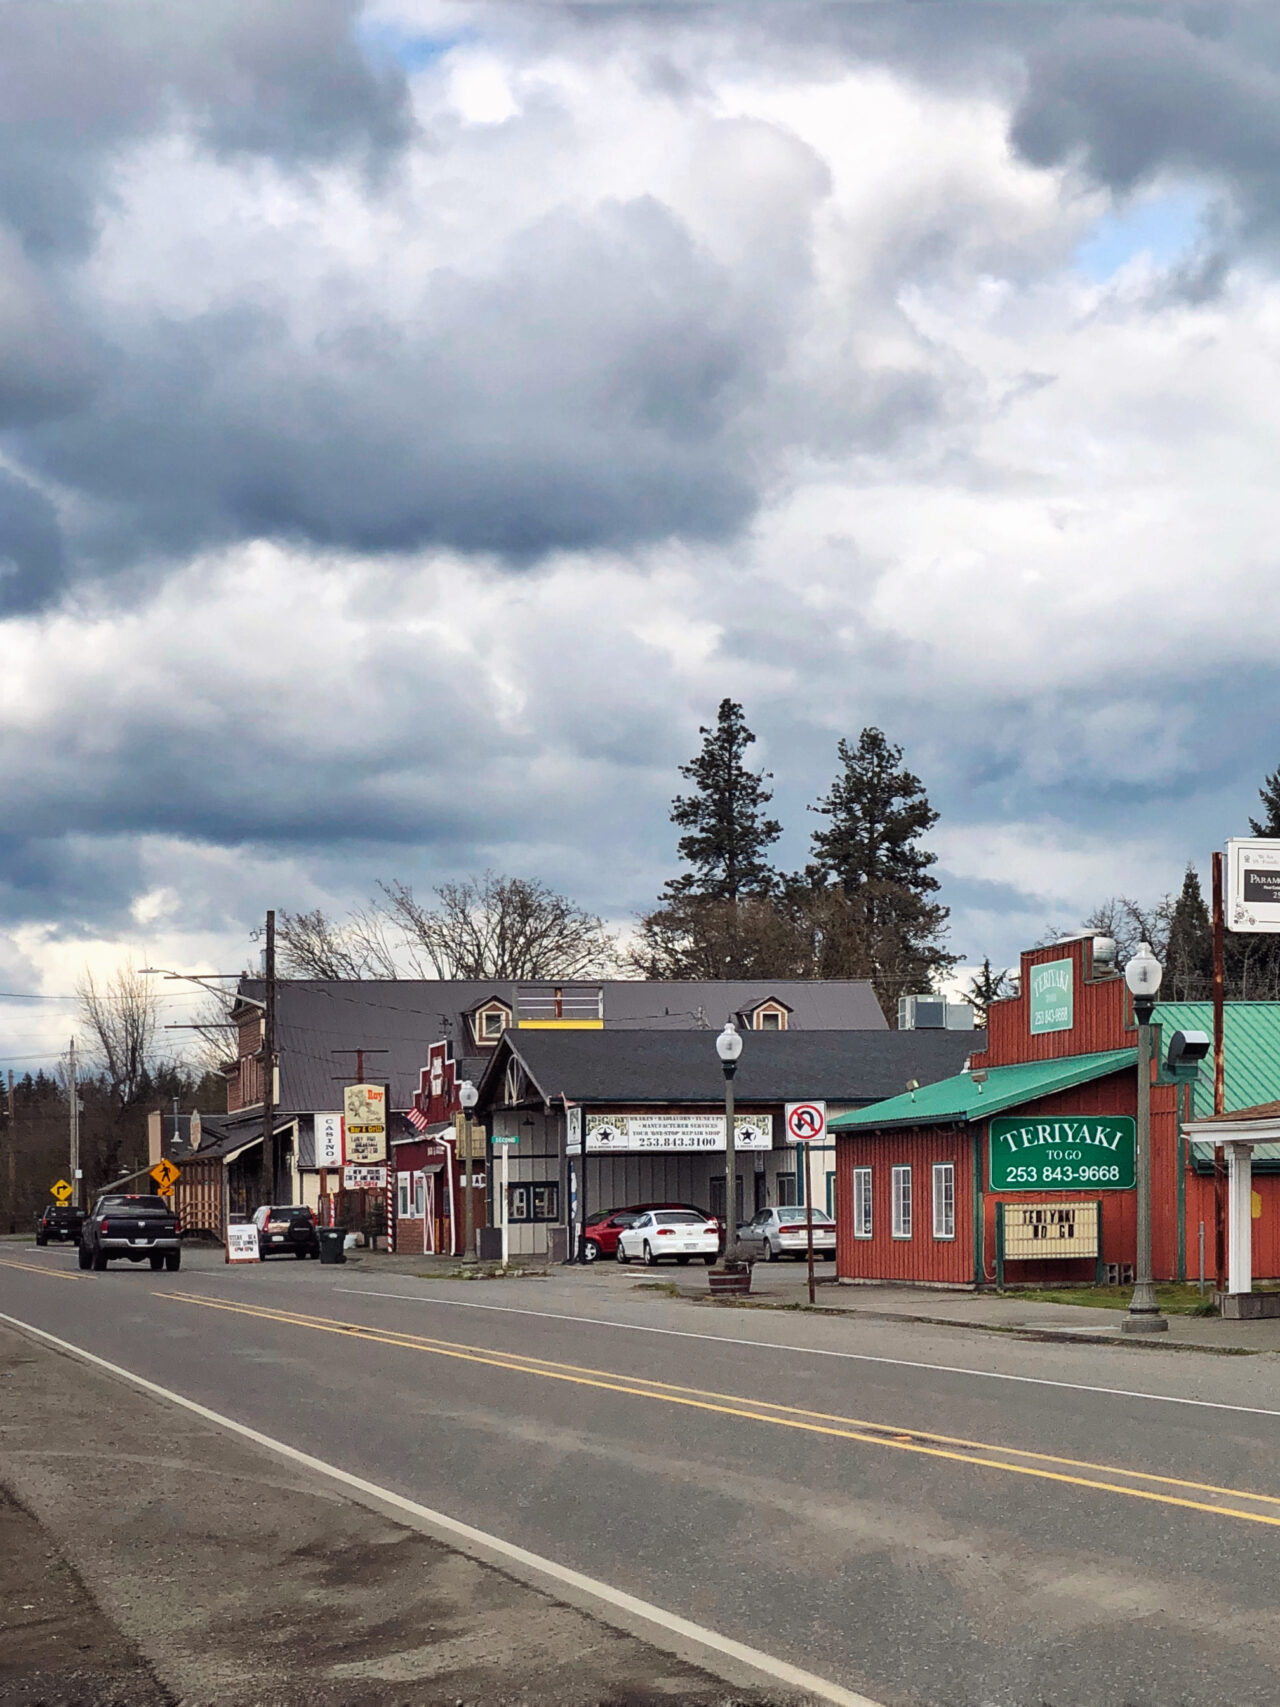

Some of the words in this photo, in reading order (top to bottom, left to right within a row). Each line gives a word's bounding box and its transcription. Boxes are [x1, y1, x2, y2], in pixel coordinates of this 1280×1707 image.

[1033, 969, 1069, 998] TERIYAKI
[368, 1090, 384, 1102] Roy
[325, 1119, 334, 1156] CASINO
[639, 1138, 716, 1147] 253.843.3100
[1000, 1123, 1123, 1152] TERIYAKI
[1046, 1150, 1062, 1160] TO
[1065, 1150, 1082, 1160] GO
[1006, 1167, 1037, 1182] 253
[1042, 1165, 1120, 1182] 843-9668
[1022, 1209, 1076, 1224] TERIYAKI
